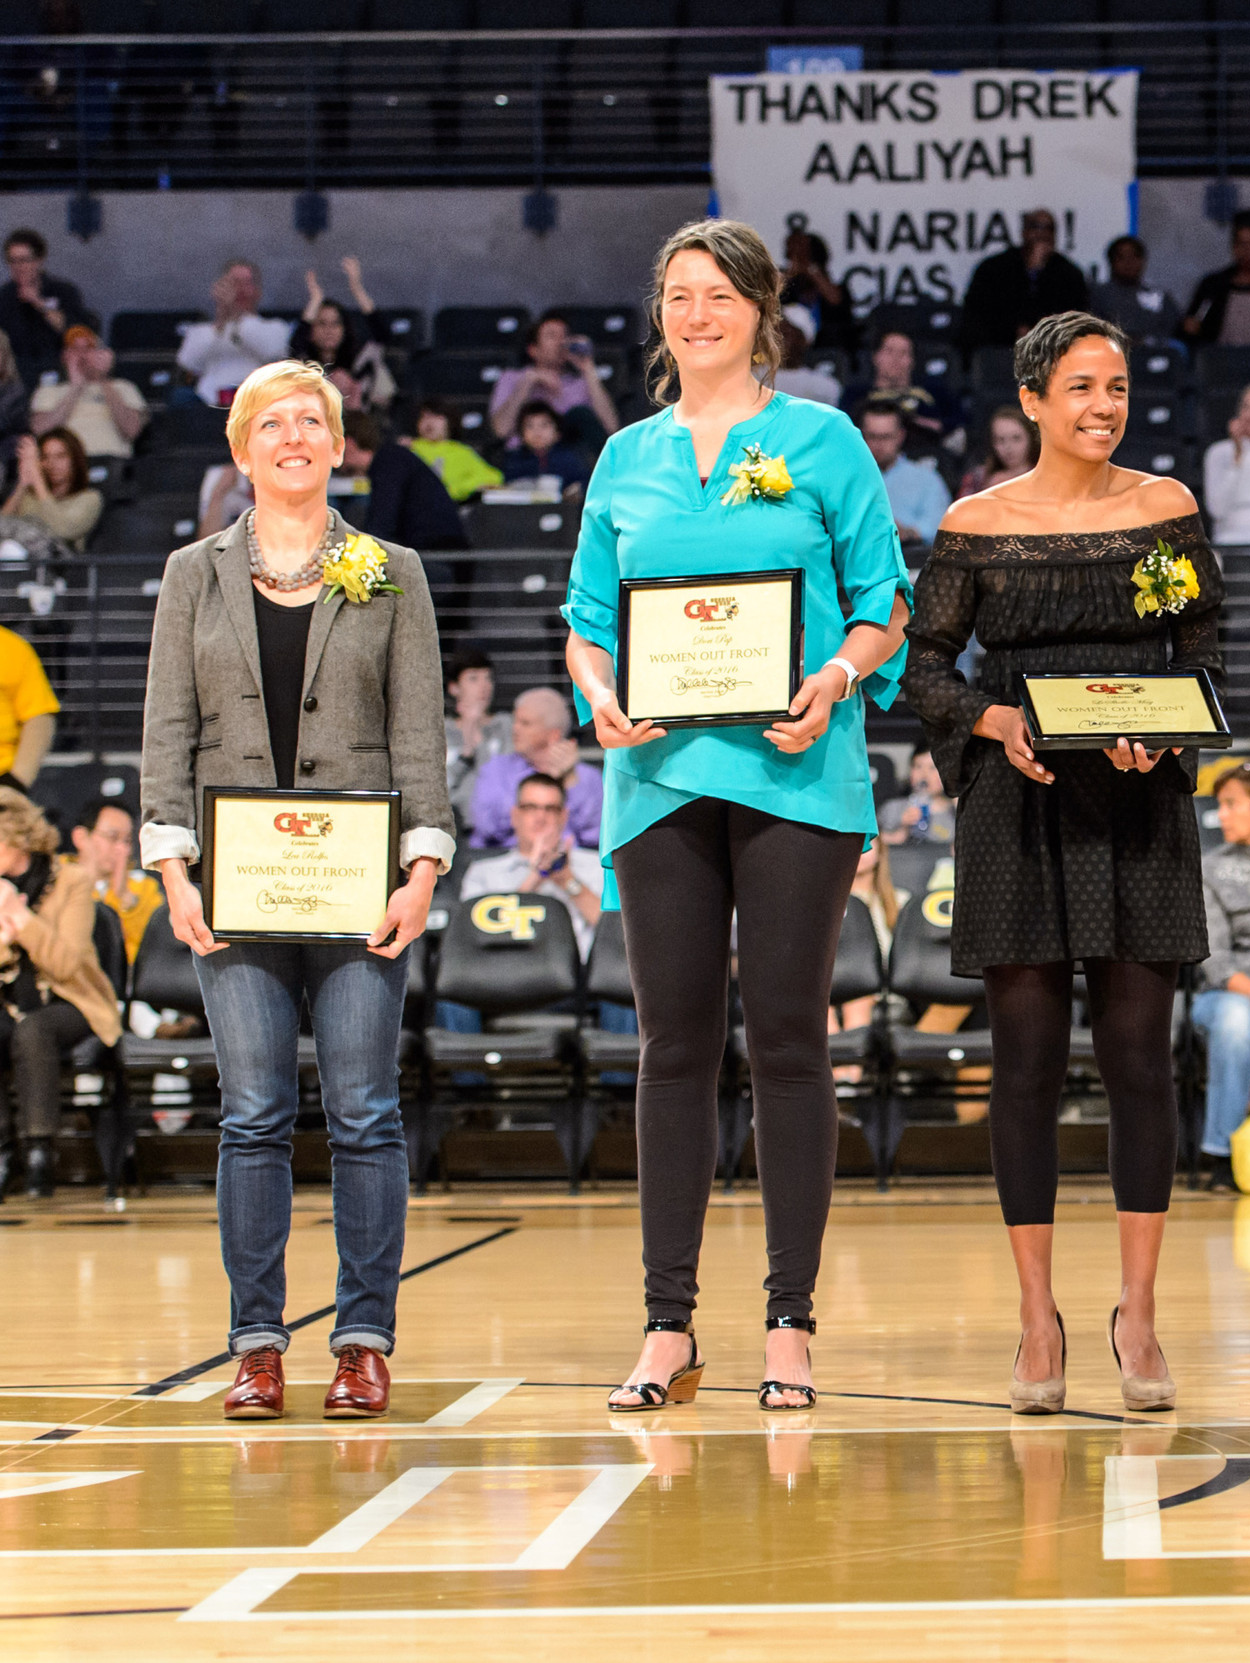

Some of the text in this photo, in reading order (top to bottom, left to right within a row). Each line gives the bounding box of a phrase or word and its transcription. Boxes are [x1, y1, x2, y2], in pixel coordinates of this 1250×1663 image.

[728, 77, 1120, 124] THANKS DREK
[805, 136, 1034, 183] AALIYAH
[846, 209, 1076, 253] NARIA!
[843, 262, 955, 305] CIAS
[650, 647, 771, 664] WOMEN OUT FRONT
[683, 665, 704, 676] Class
[237, 865, 367, 878] WOMEN OUT FRONT
[273, 880, 295, 891] Class
[471, 894, 546, 940] GT
